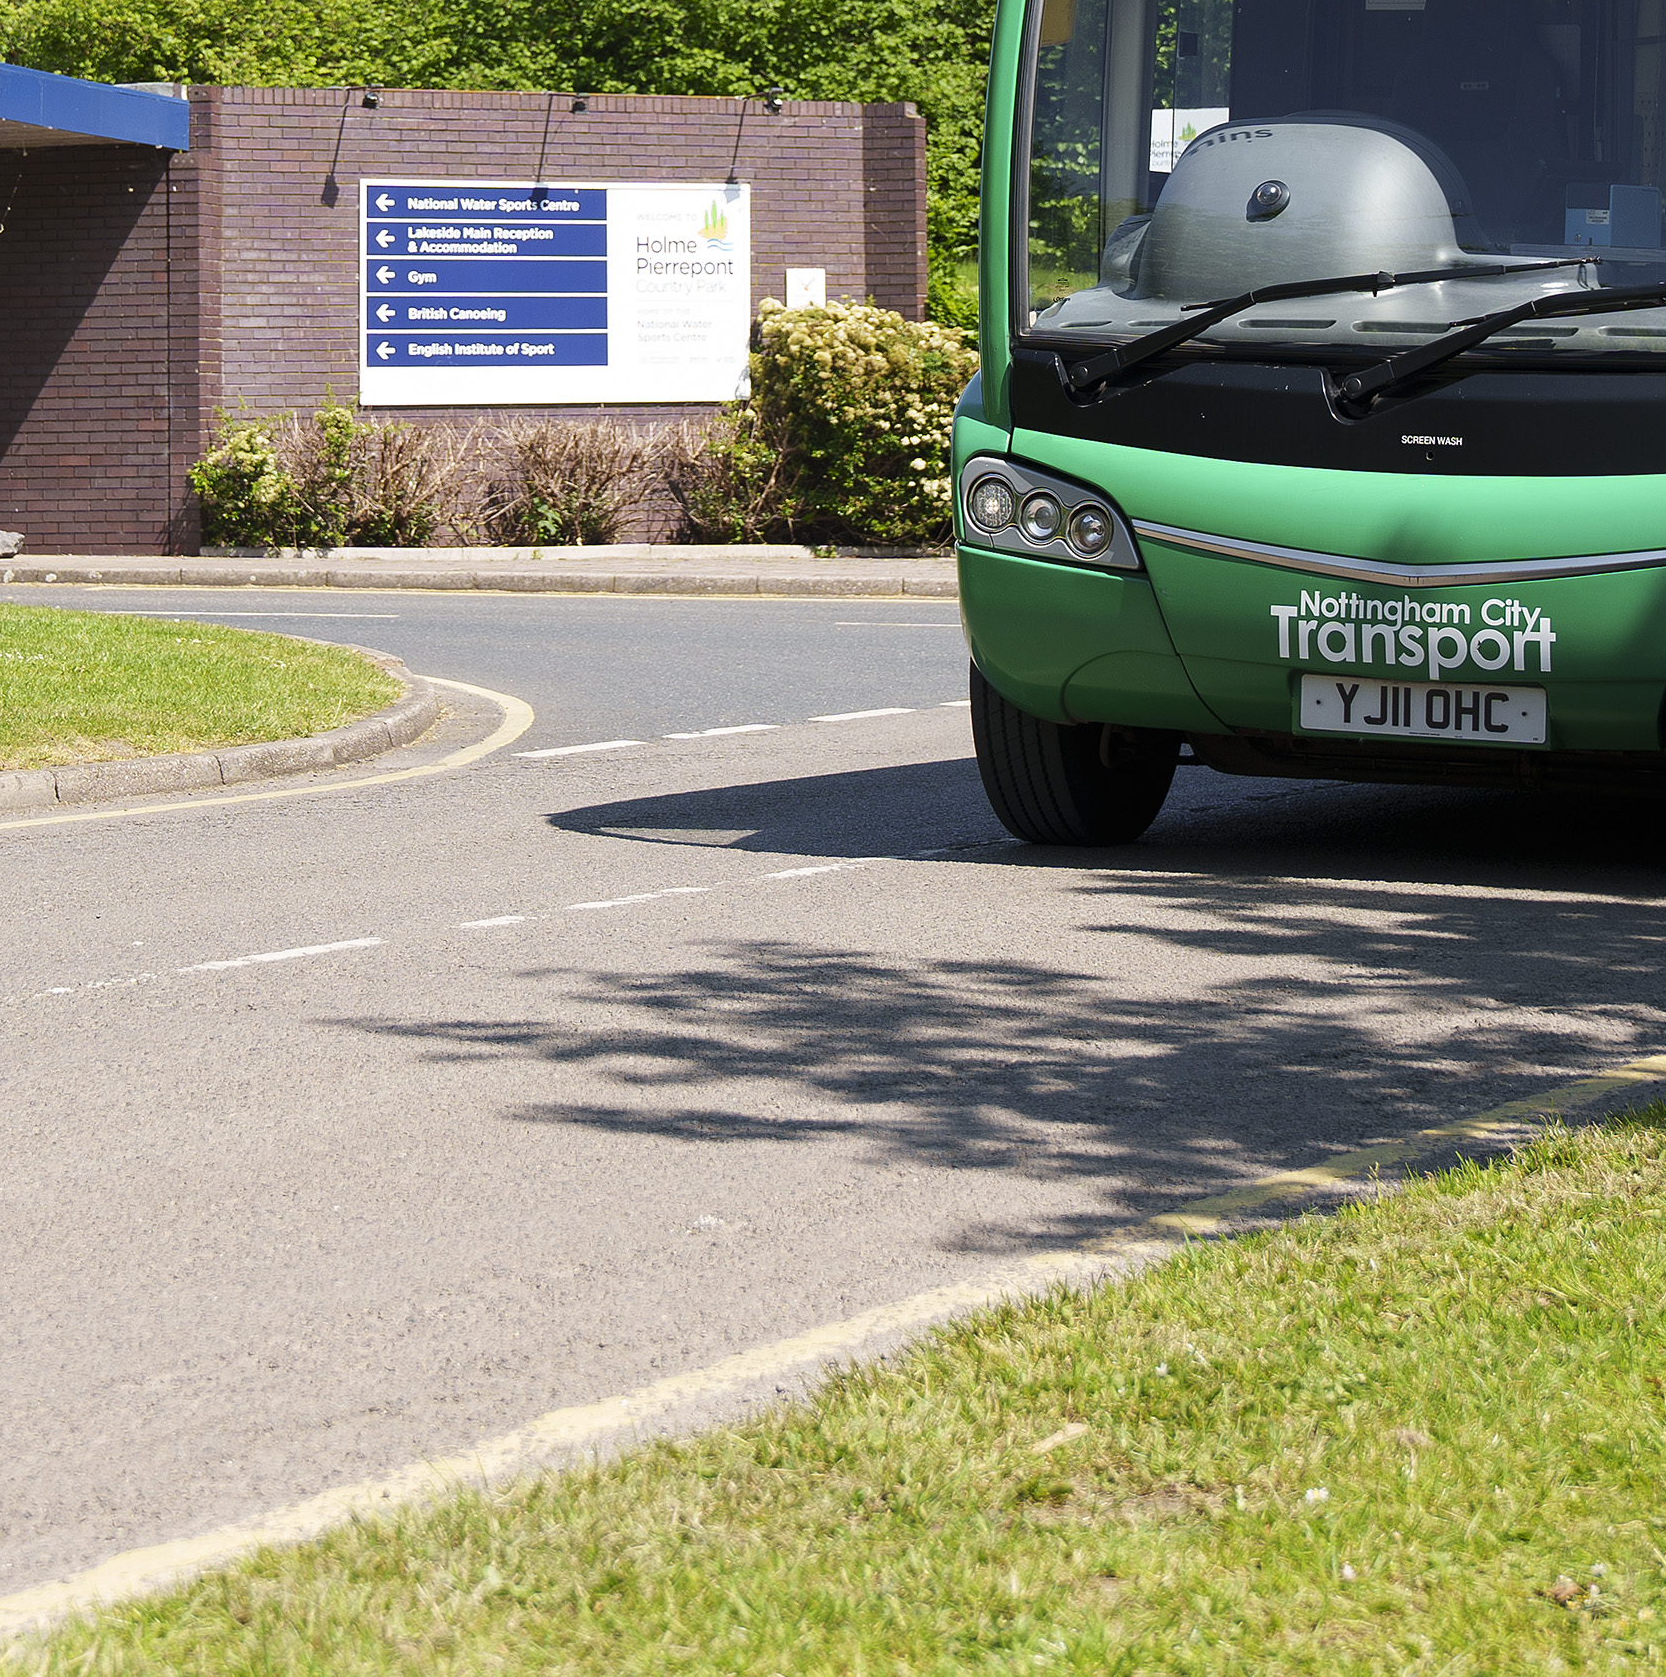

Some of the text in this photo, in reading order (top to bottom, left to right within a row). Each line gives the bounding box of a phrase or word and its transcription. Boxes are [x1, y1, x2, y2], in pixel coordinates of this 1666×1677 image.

[407, 197, 580, 213] National Water Sports Centre
[407, 226, 554, 241] Lakeside Main Reception
[407, 241, 518, 254] & Accommodation
[636, 236, 697, 253] Holme
[636, 257, 734, 278] Pierrepont
[407, 270, 437, 285] Gym
[636, 279, 727, 296] Country Park
[408, 307, 507, 322] British Canoeing
[637, 320, 712, 329] National Water
[637, 332, 707, 342] Sports Centre
[408, 342, 555, 357] English Institute of Sport
[1401, 434, 1463, 446] SCREEN WASH
[1300, 589, 1541, 637] Nottingham City
[1270, 605, 1556, 680] Transport
[1335, 682, 1510, 733] YJ11 OHC
